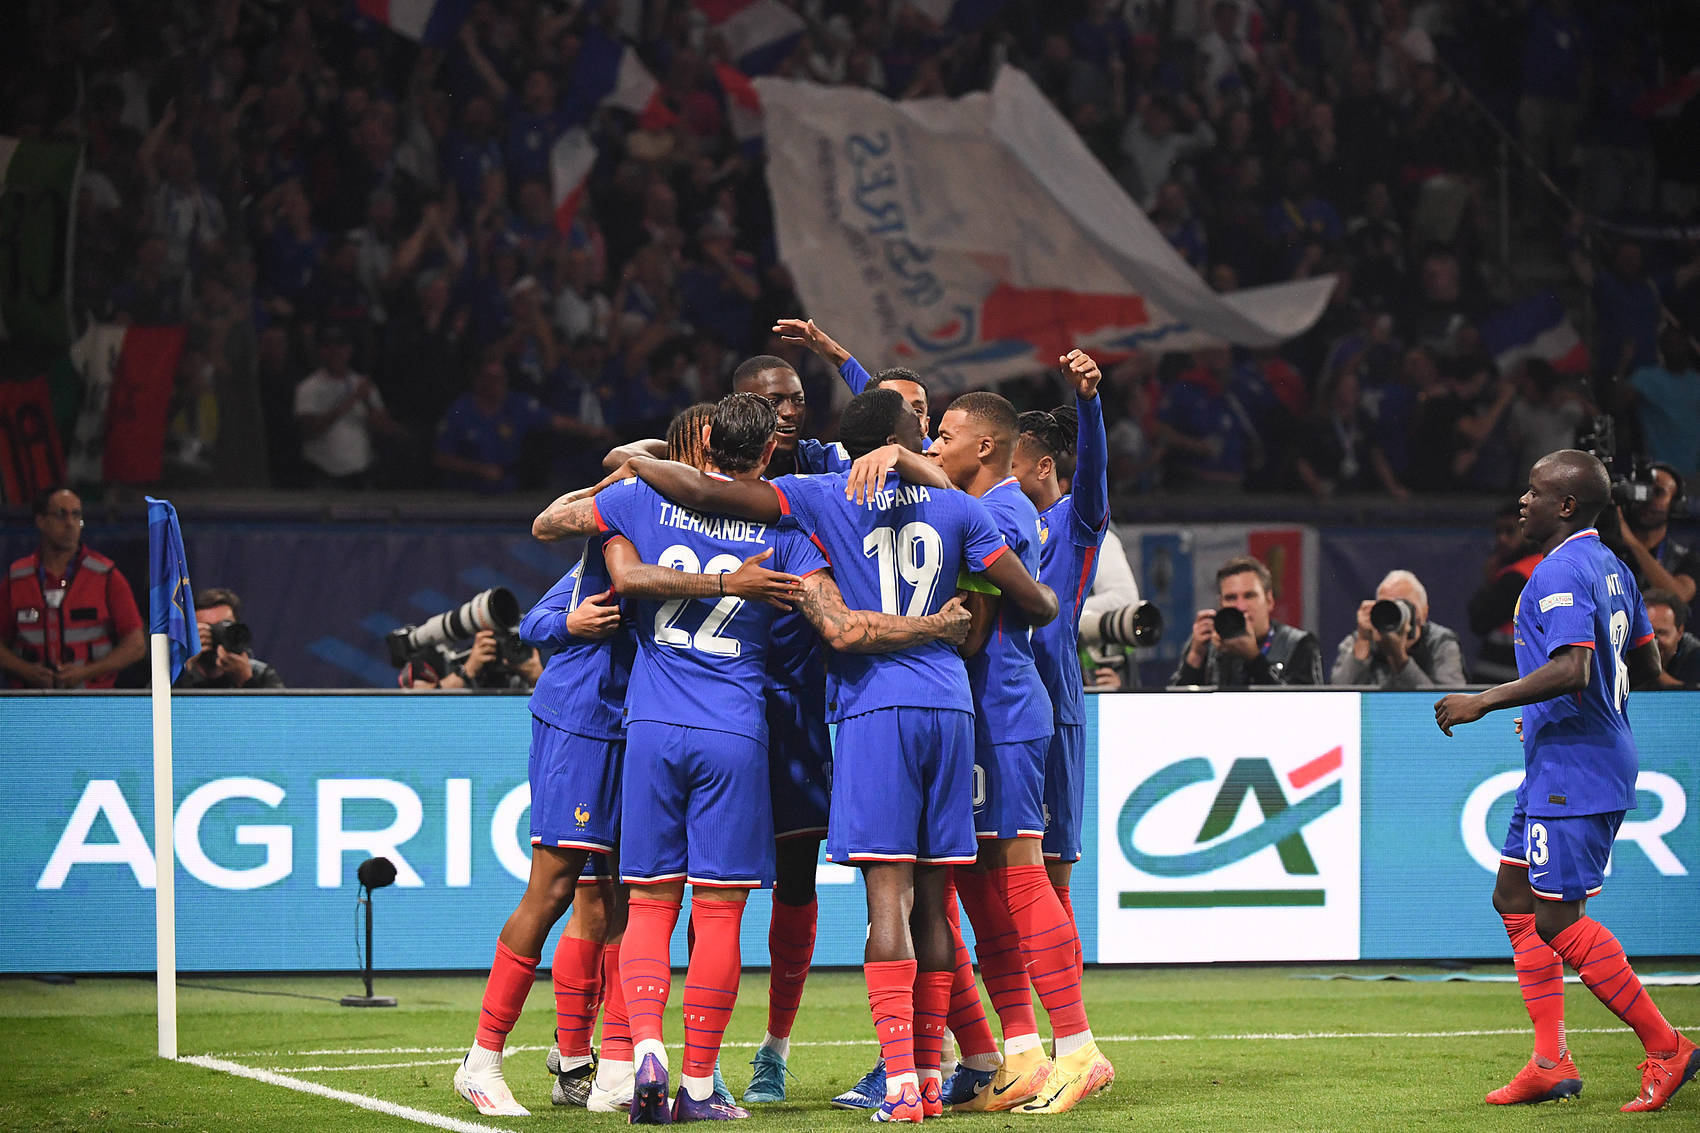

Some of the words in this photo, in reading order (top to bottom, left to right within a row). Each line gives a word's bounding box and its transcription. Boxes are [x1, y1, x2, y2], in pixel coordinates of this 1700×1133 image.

[659, 502, 767, 544] T.HERNANDEZ
[863, 522, 943, 617] 19
[654, 544, 745, 658] 22
